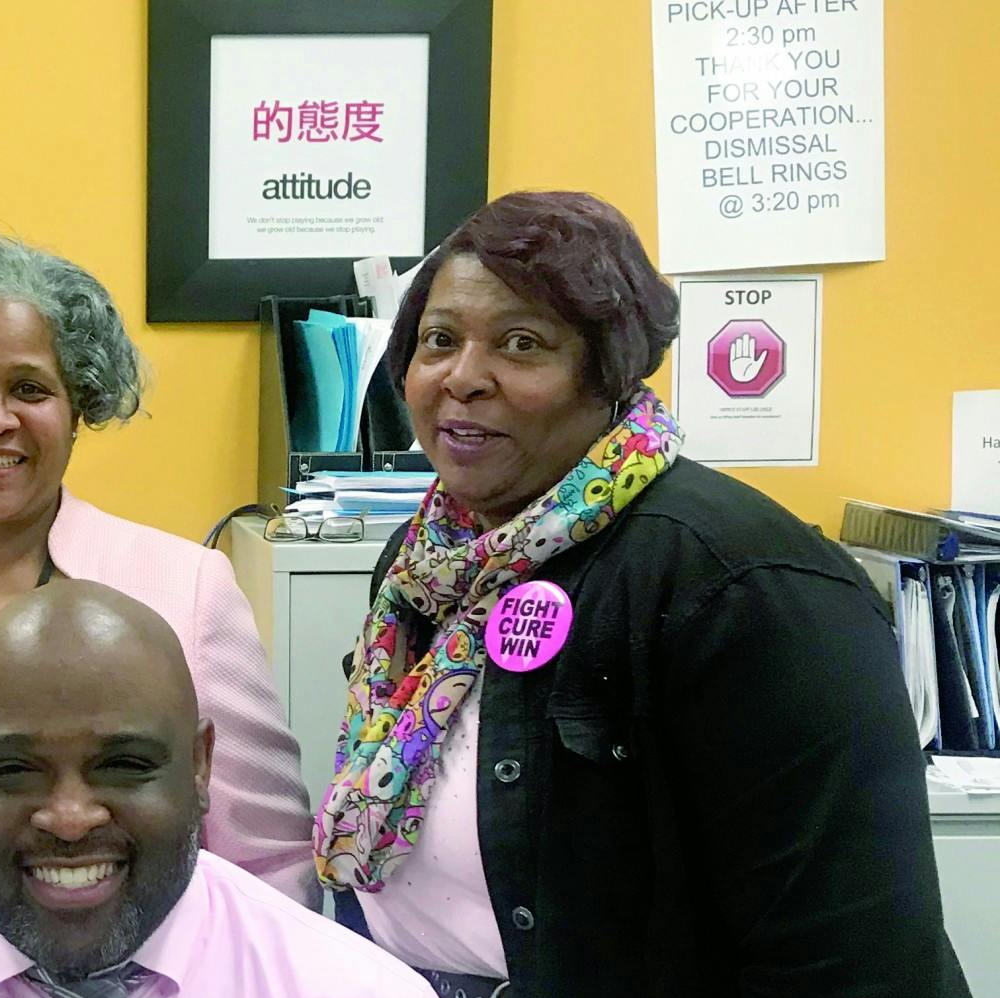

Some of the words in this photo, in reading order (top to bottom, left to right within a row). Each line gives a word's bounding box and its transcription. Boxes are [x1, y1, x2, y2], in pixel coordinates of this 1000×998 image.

[667, 0, 769, 23] PICK-UP
[726, 25, 774, 47] 2:30
[782, 26, 816, 47] pm
[695, 53, 780, 76] THANK
[788, 49, 840, 70] YOU
[708, 82, 760, 103] FOR
[767, 77, 839, 99] YOUR
[252, 99, 385, 143] 的態度
[670, 104, 873, 134] COOPERATION...
[705, 133, 838, 160] DISMISSAL
[261, 171, 372, 200] attitude
[702, 165, 764, 188] BELL
[771, 160, 848, 183] RINGS
[719, 194, 744, 219] @
[751, 190, 800, 213] 3:20
[807, 192, 840, 214] pm
[724, 289, 773, 306] STOP
[500, 597, 563, 619] FIGHT
[498, 617, 555, 639] CURE
[500, 637, 541, 658] WIN
